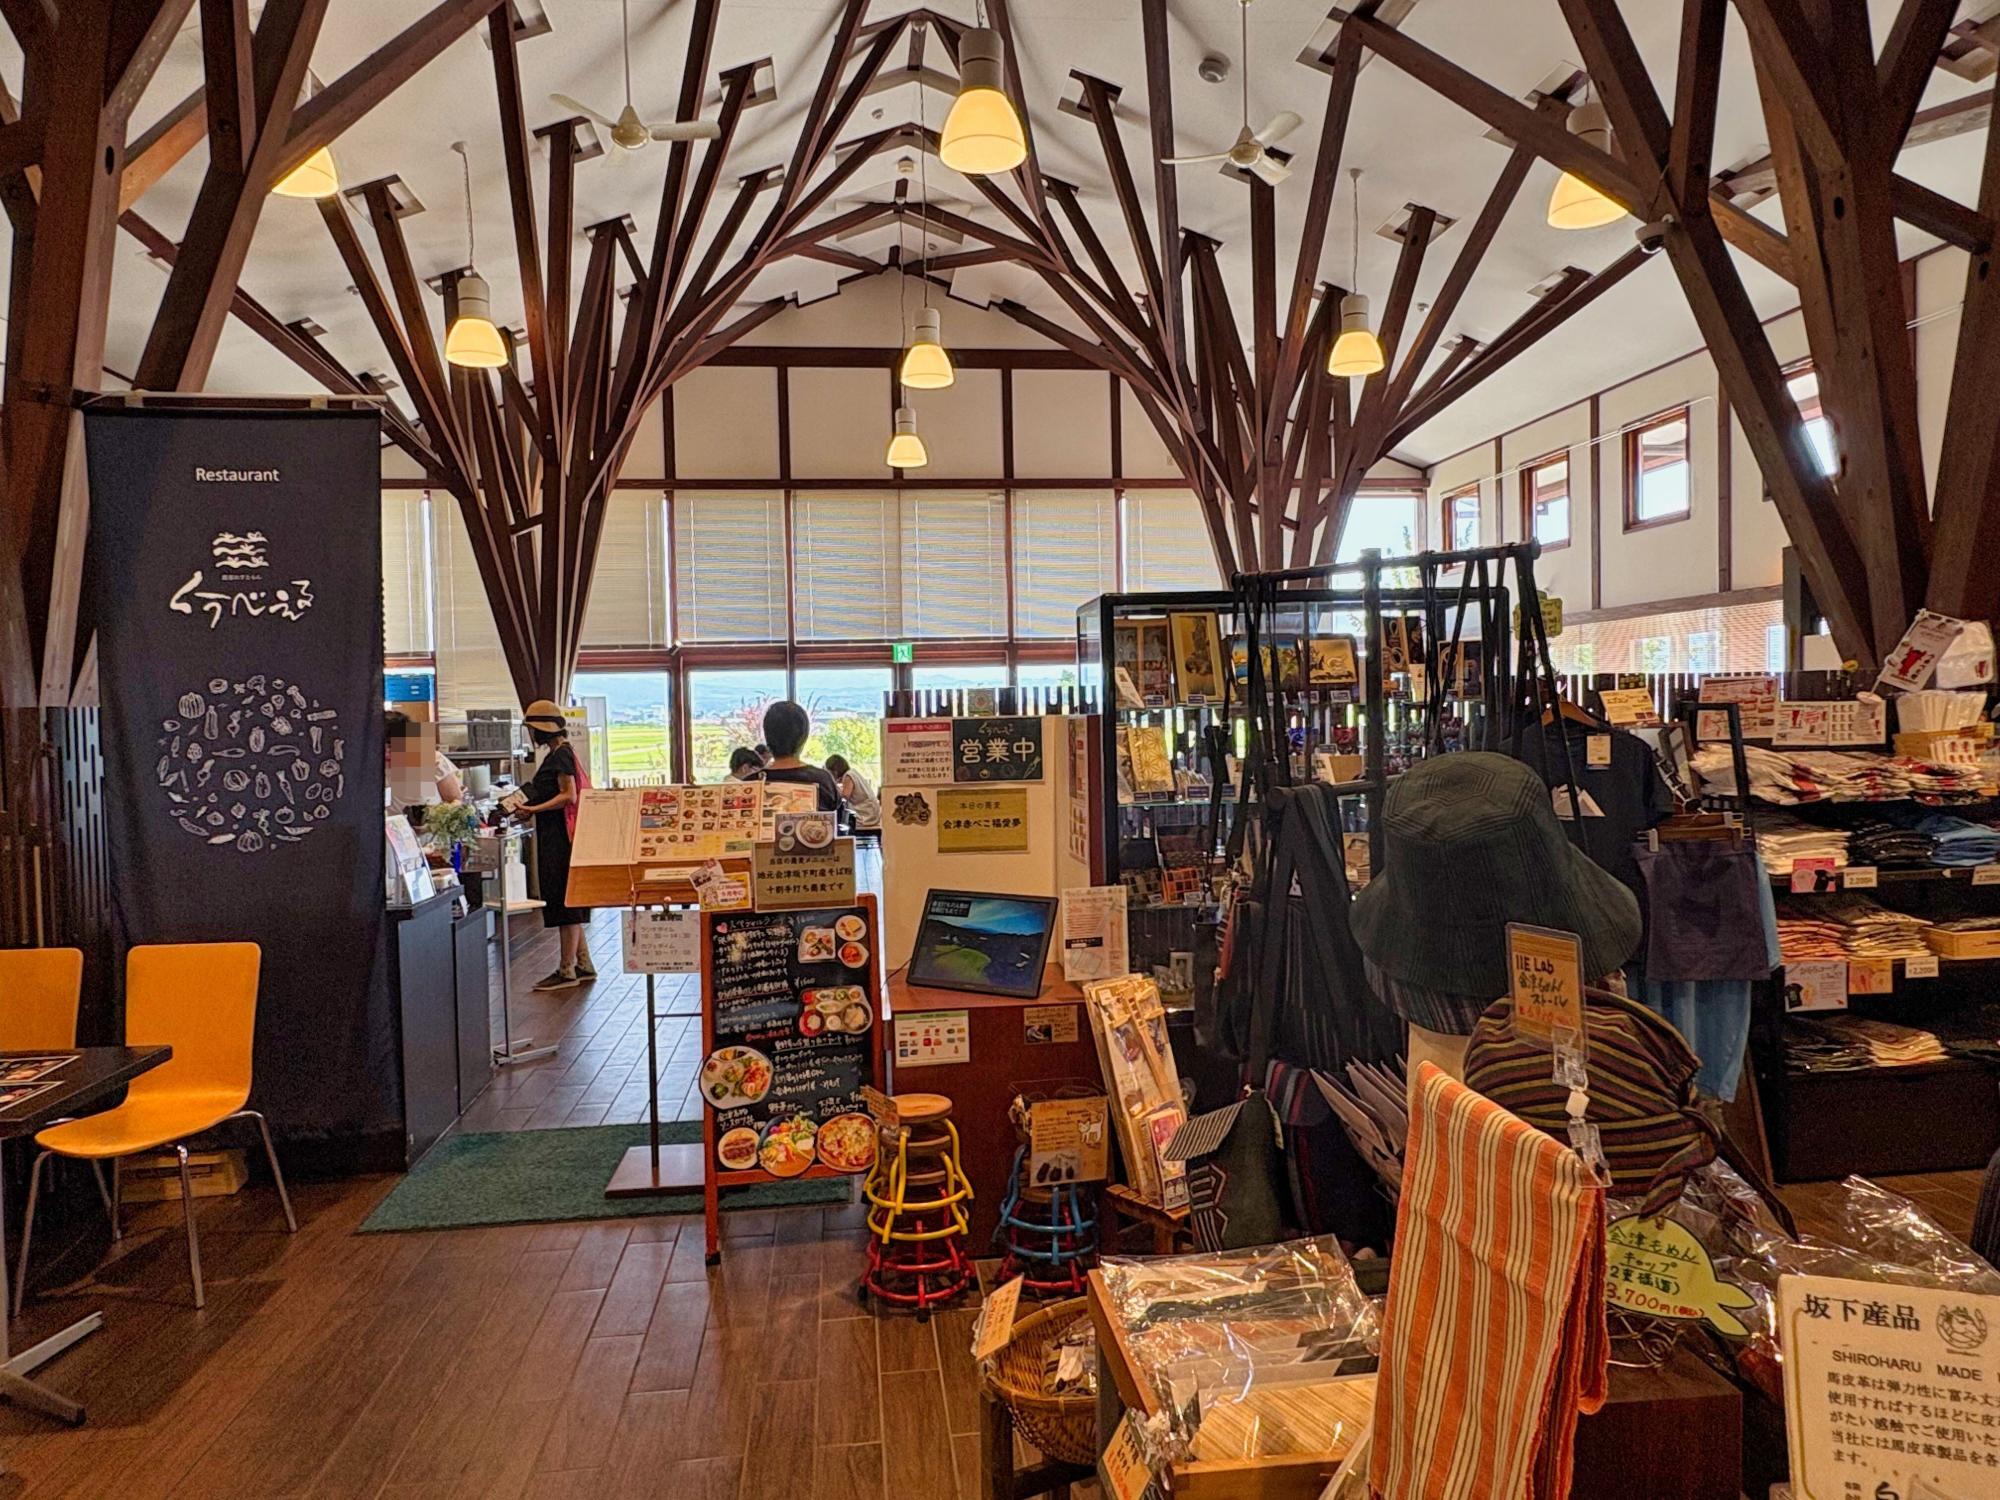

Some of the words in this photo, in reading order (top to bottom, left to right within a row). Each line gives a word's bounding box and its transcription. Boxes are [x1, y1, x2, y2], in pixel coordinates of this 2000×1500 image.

[195, 467, 280, 482] Restaurant
[960, 737, 1036, 764] 営業中
[1533, 957, 1554, 975] Lab
[1530, 993, 1568, 1008] ストール
[1609, 1225, 1697, 1262] 会津もめん
[1623, 1251, 1678, 1273] キャップ
[1802, 1293, 1921, 1331] 坂下産品
[1832, 1350, 1922, 1373] SHIROHARU
[1937, 1364, 1983, 1381] MADE
[1828, 1390, 2000, 1428] 使用すればするほどに皮
[1829, 1410, 2000, 1448] がたい感触でご使用いた
[1833, 1449, 1868, 1467] ます。
